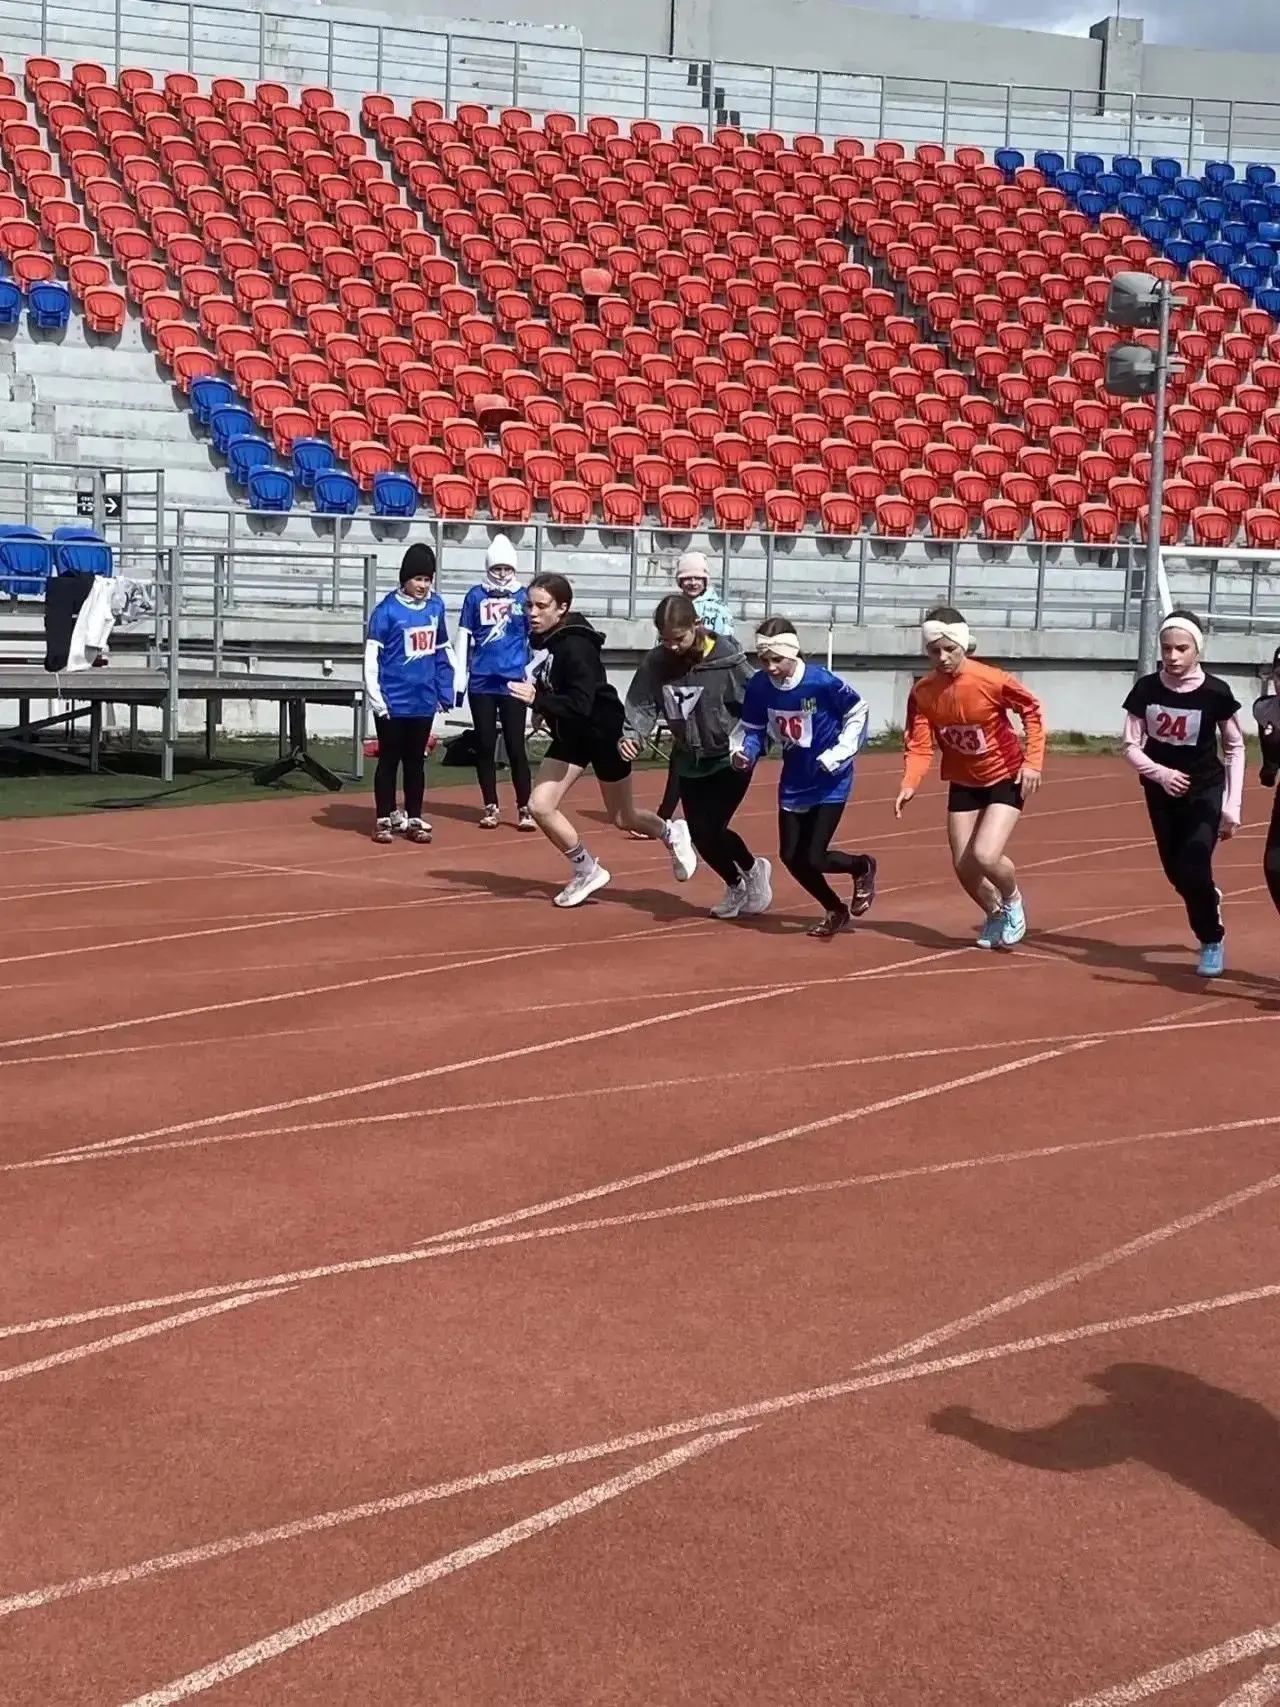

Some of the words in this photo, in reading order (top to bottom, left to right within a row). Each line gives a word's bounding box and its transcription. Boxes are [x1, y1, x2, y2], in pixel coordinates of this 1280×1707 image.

[409, 630, 435, 651] 187
[775, 715, 803, 740] 26
[1156, 712, 1188, 741] 24
